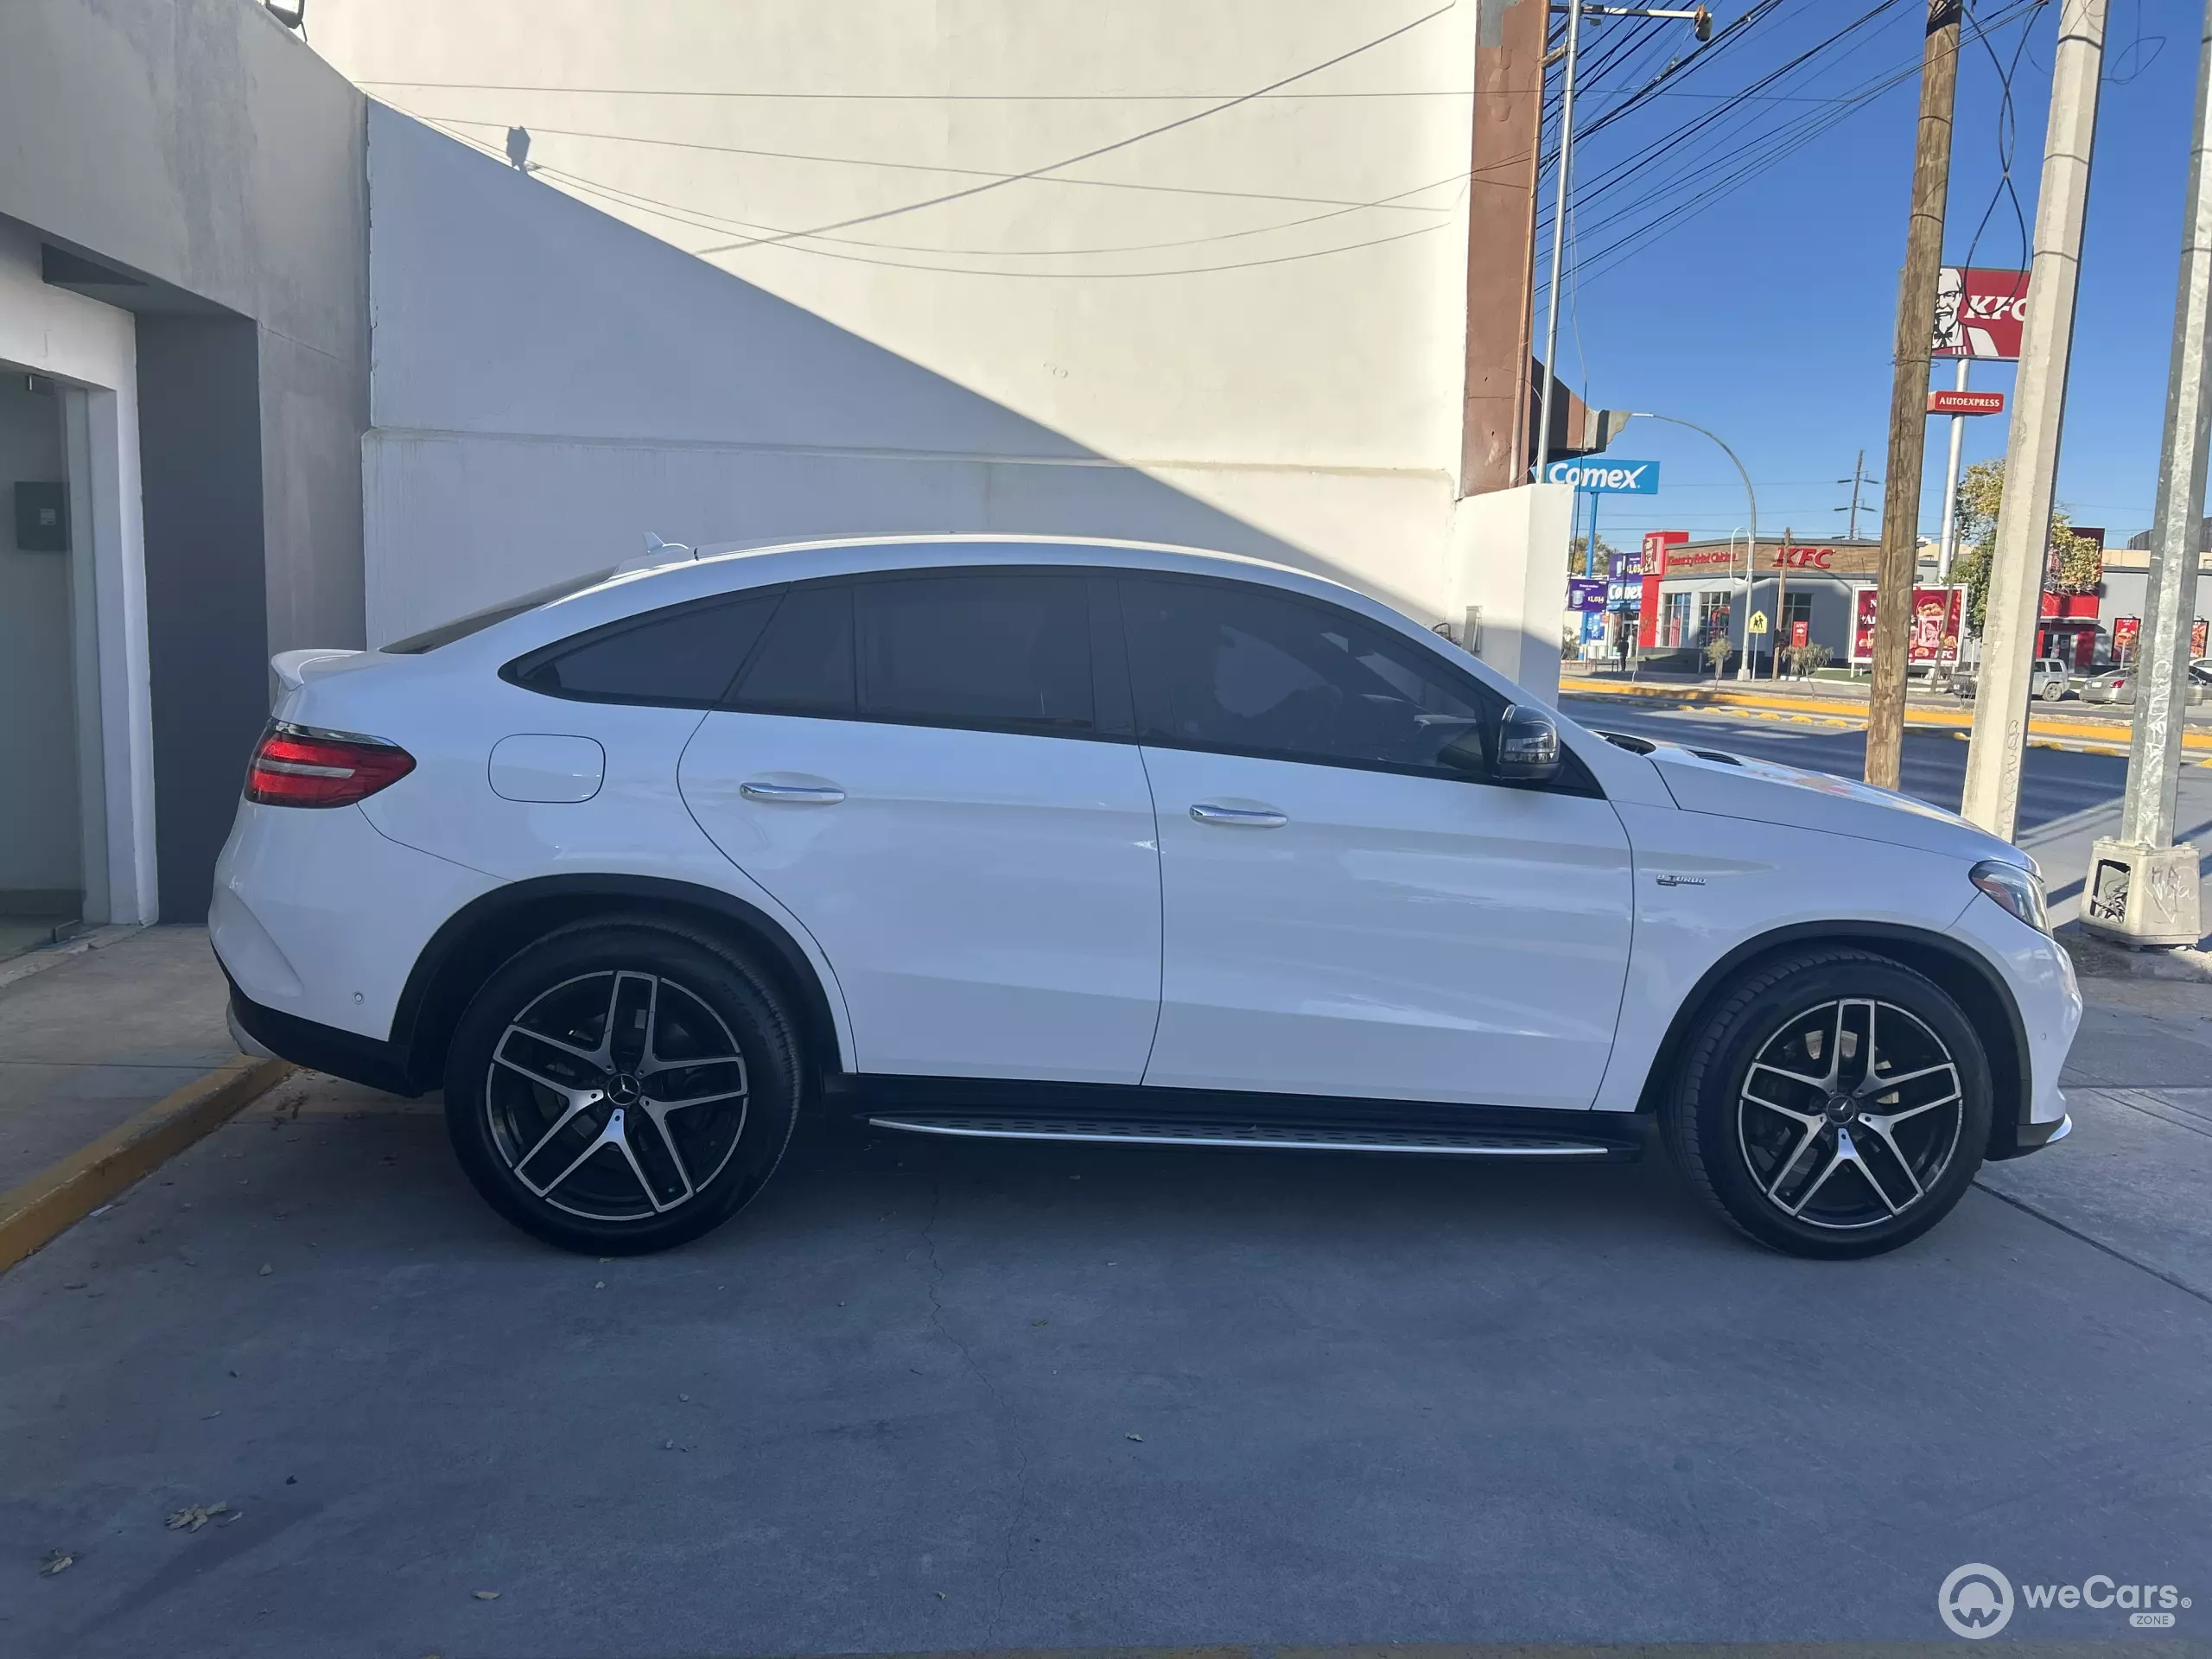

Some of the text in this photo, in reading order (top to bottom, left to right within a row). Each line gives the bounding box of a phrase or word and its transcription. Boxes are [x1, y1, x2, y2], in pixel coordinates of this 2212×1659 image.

[1939, 397, 1999, 407] AUTOEXPRESS
[1549, 462, 1648, 489] Comex
[1771, 548, 1833, 569] KFC
